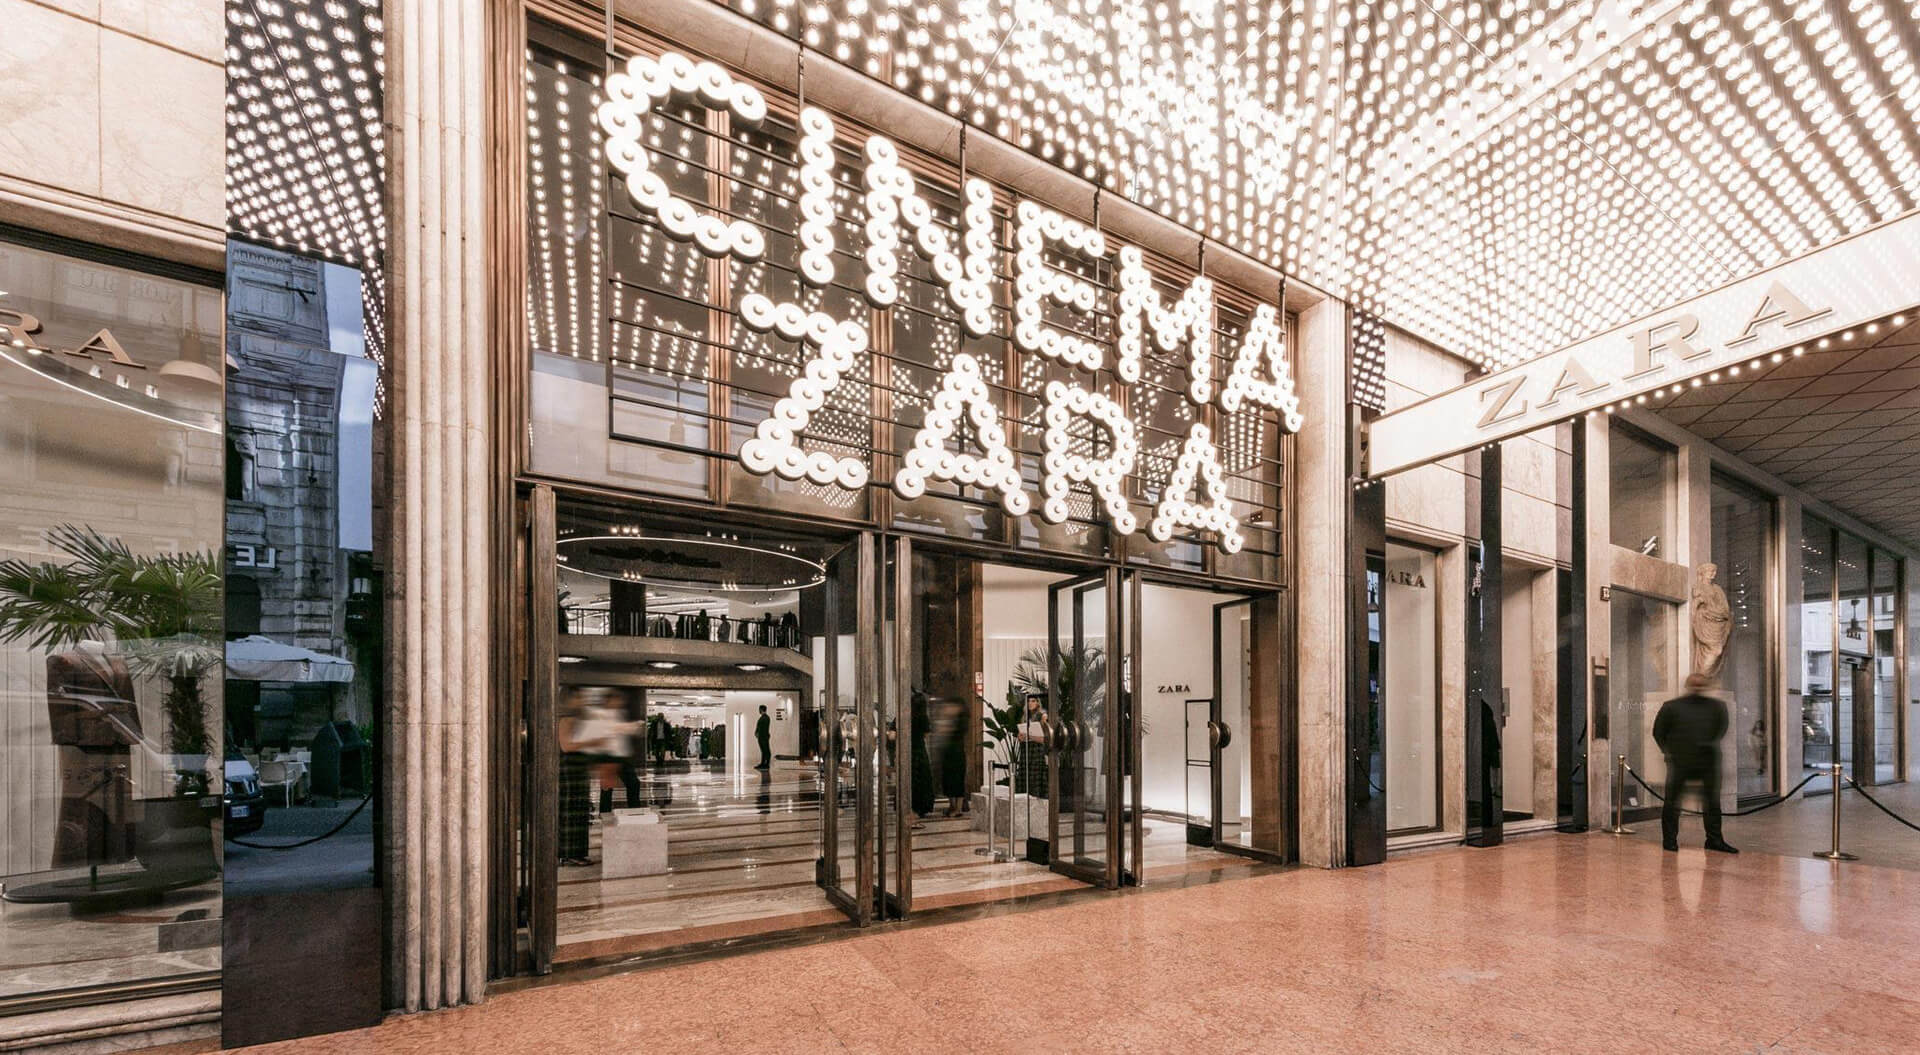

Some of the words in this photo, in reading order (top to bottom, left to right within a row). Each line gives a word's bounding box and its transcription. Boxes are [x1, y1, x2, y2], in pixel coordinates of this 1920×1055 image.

[598, 52, 1302, 434] CINEMA
[739, 292, 1246, 555] ZARA
[1475, 280, 1833, 429] ZARA
[1157, 684, 1191, 694] ZARA
